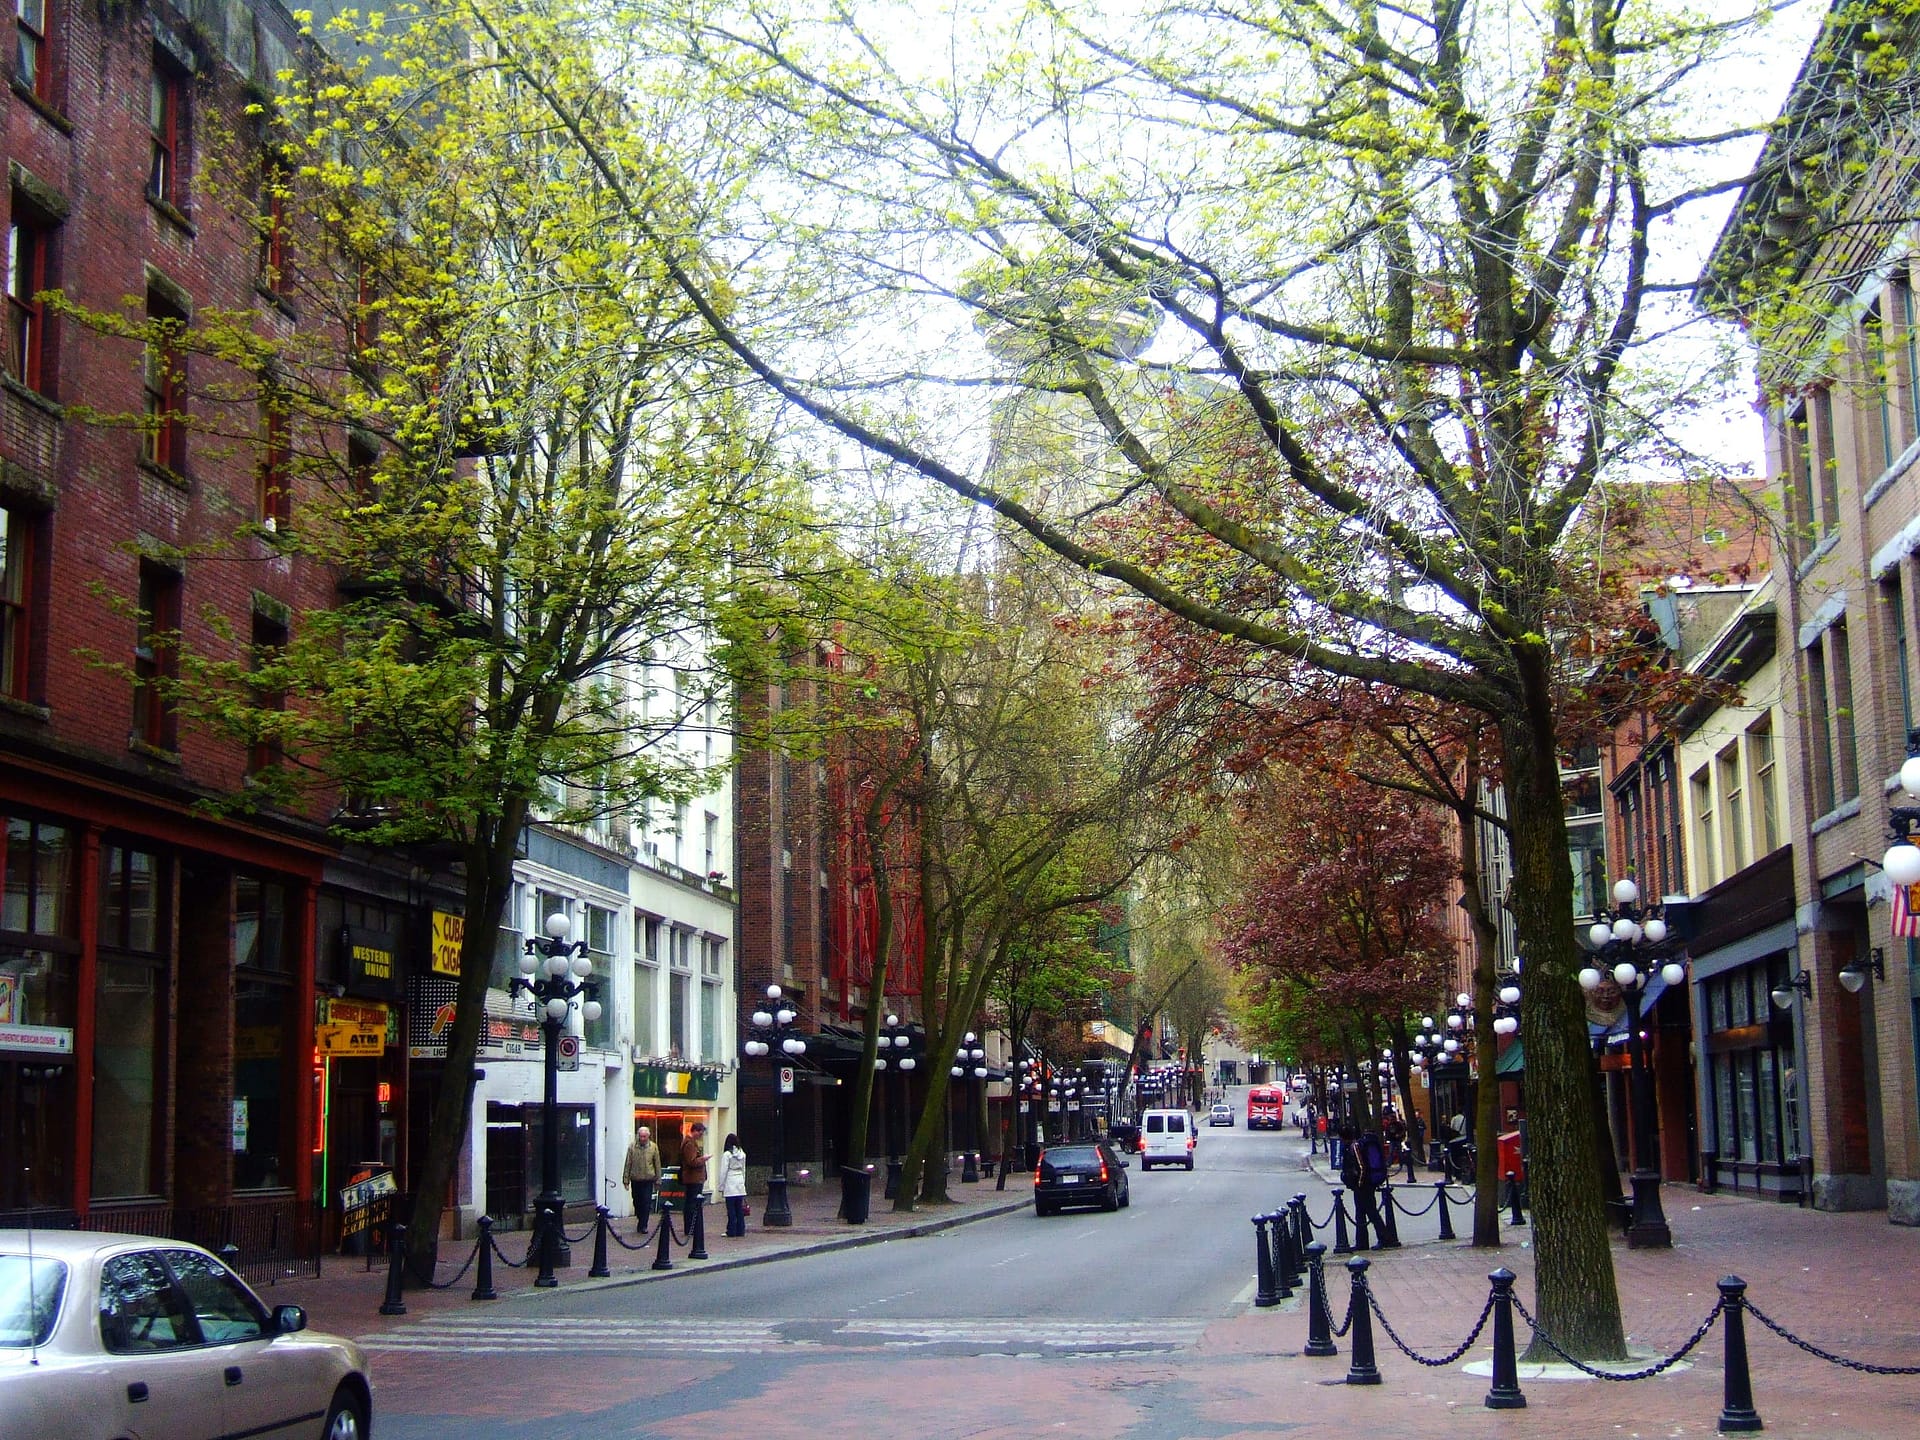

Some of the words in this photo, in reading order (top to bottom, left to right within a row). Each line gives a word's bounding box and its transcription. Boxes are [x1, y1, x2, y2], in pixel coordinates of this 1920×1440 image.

[353, 945, 390, 965] WESTERN
[365, 962, 390, 979] UNION
[350, 1034, 379, 1045] ATM
[506, 1042, 522, 1055] CIGAR
